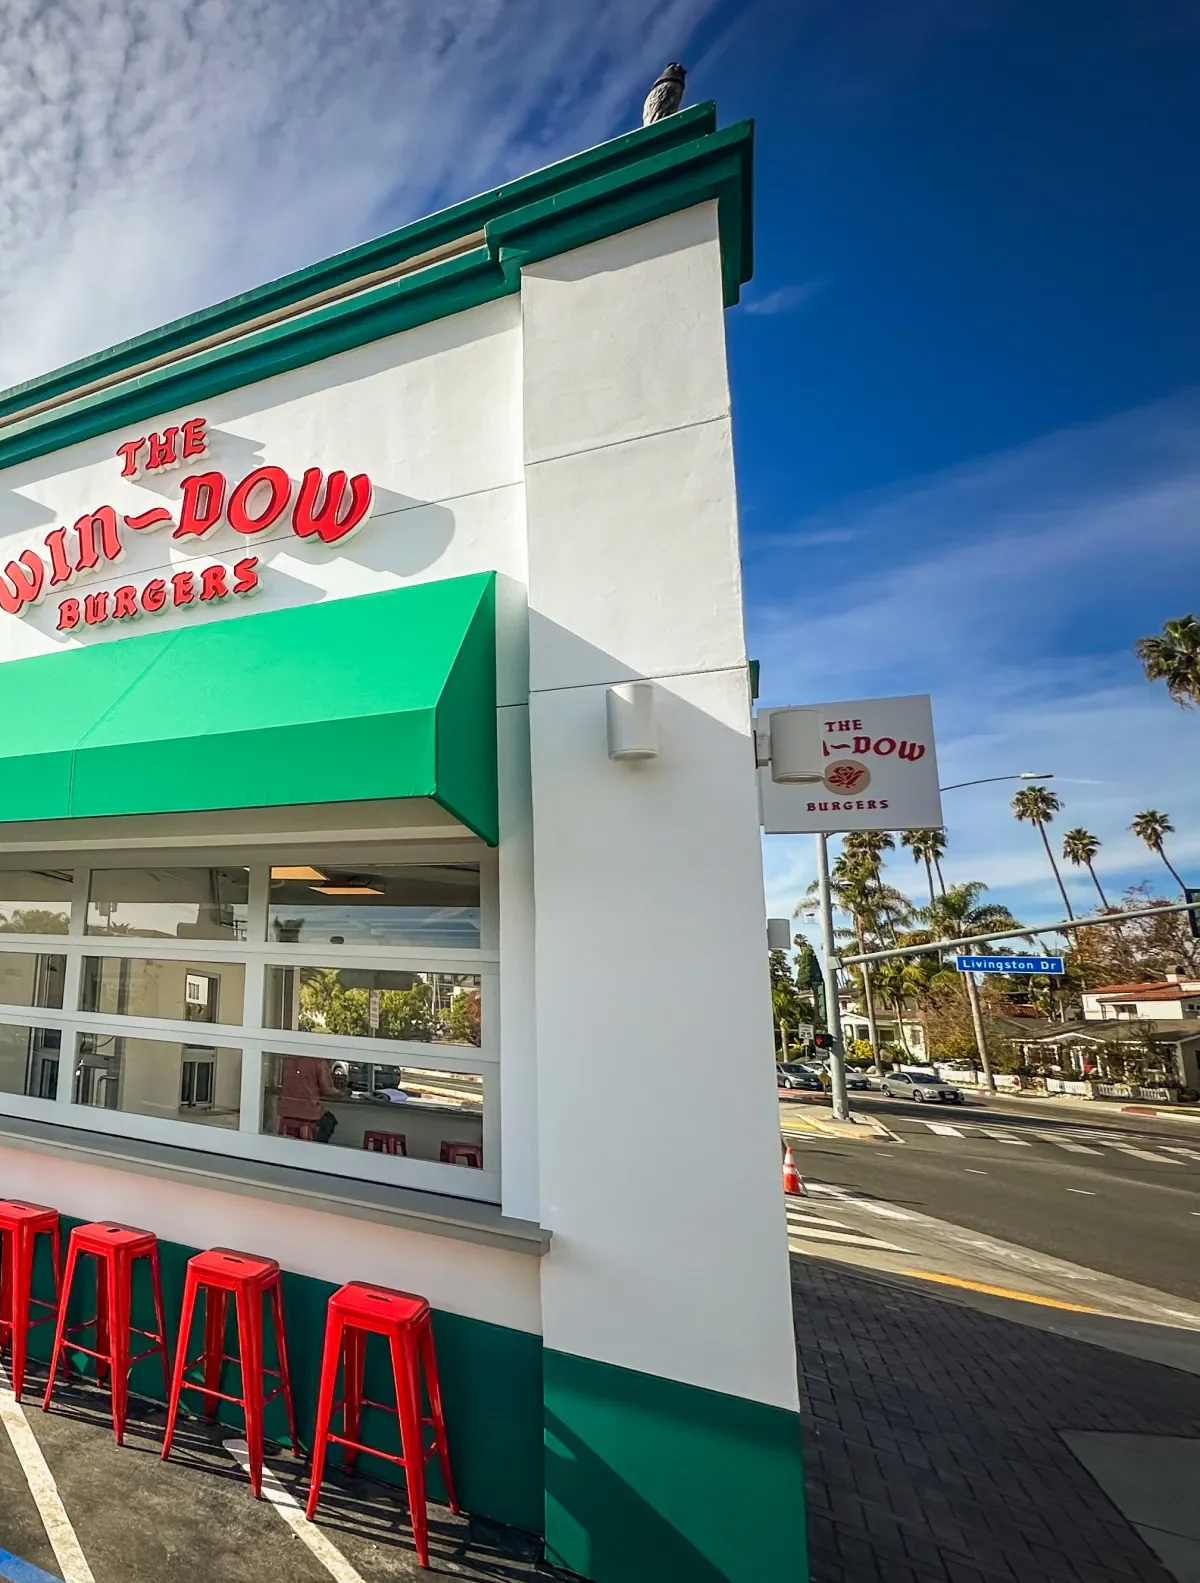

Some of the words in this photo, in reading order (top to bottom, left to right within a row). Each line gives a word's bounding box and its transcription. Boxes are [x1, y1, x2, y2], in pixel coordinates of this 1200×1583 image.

[116, 417, 209, 479] THE
[56, 556, 261, 632] BURGERS
[824, 719, 863, 733] THE
[806, 799, 889, 812] BURGERS
[962, 959, 1034, 971] Livingston
[1040, 961, 1057, 970] Dr
